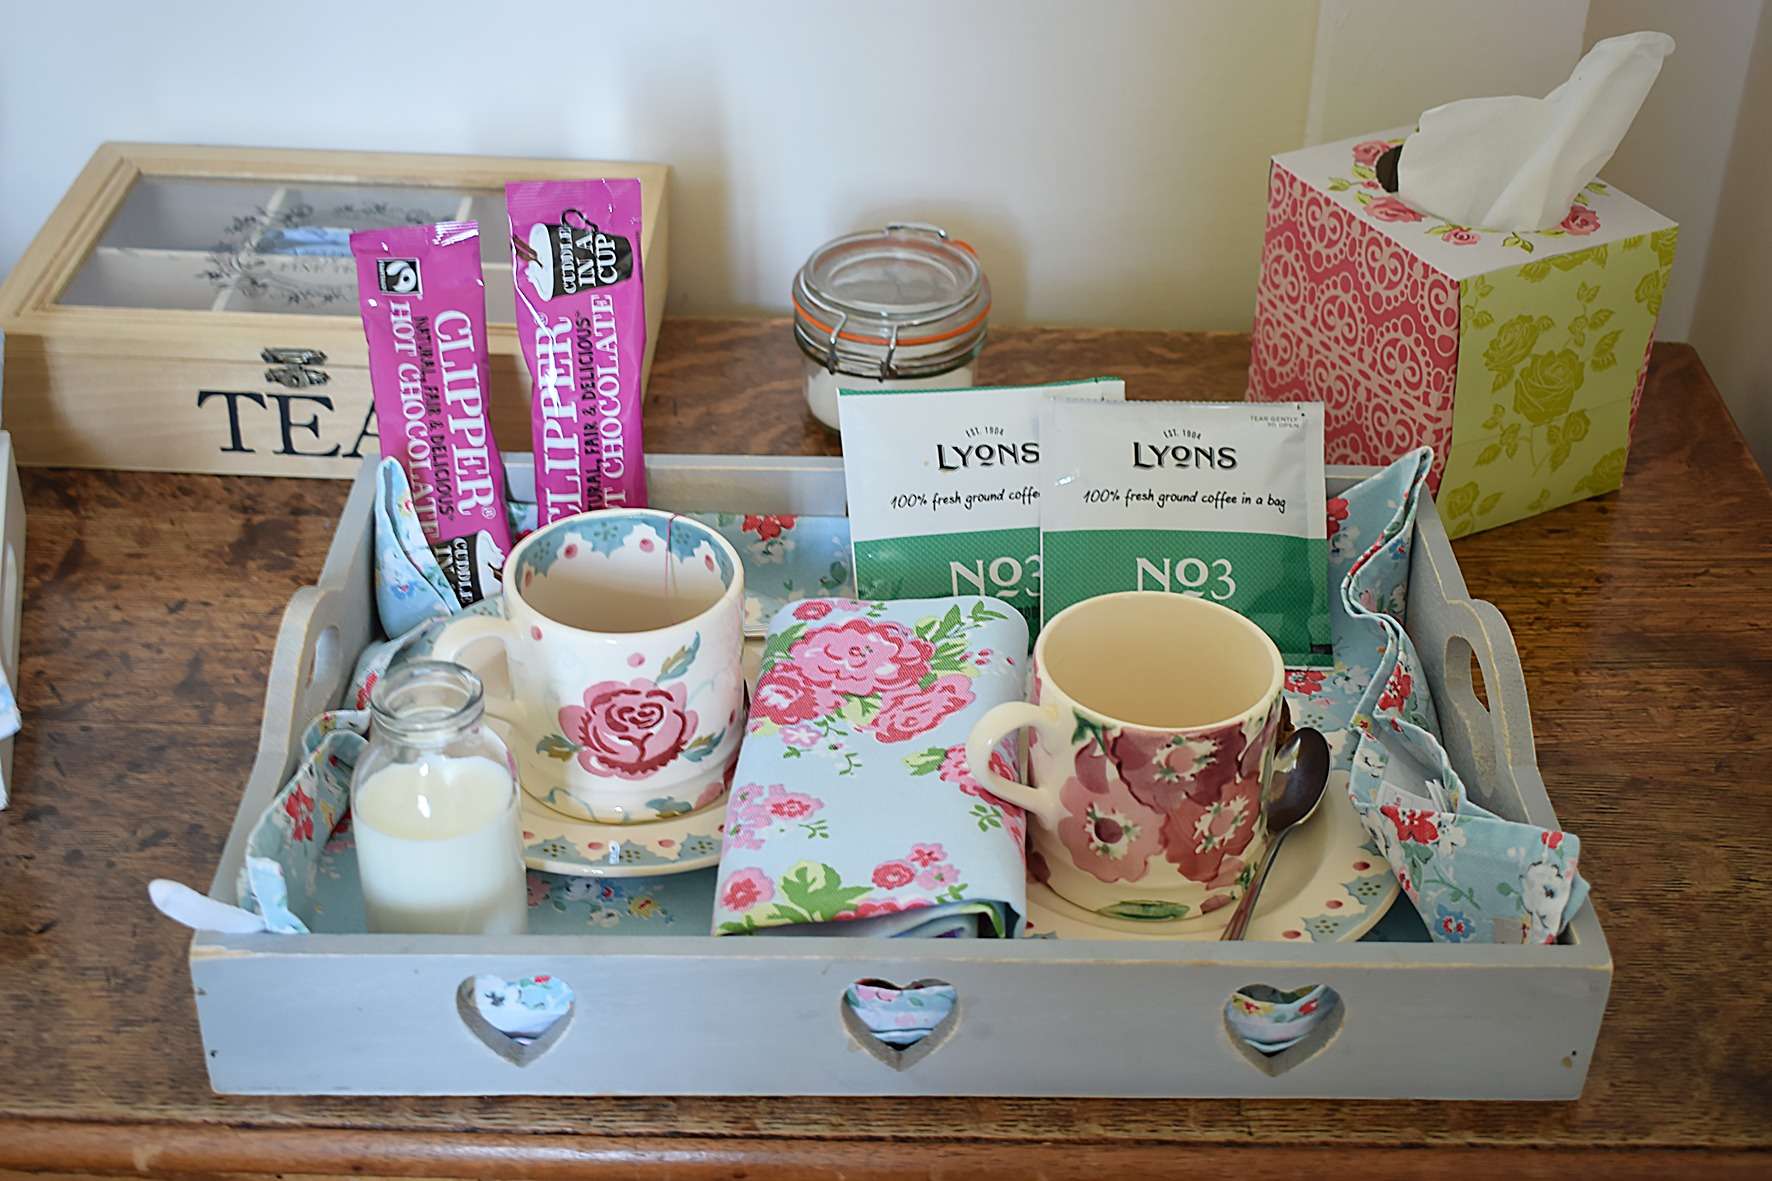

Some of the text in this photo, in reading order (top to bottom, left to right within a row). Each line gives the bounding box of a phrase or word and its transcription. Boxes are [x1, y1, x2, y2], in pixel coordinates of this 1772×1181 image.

[559, 226, 576, 294] CUDDLE
[575, 232, 597, 288] IN A
[595, 233, 618, 285] CUP
[423, 384, 442, 417] FAIR
[591, 294, 625, 480] CHOCOLATE
[390, 300, 440, 539] HOT CHOCOLATE
[429, 419, 444, 433] &
[582, 406, 597, 416] &
[584, 424, 599, 456] FAIR
[1132, 441, 1237, 470] LYONS
[936, 442, 1040, 471] LYONS
[890, 485, 1041, 512] 100% fresh ground coffe
[1083, 488, 1287, 515] 100% fresh ground coffee in a bag
[453, 537, 474, 604] CUDDLE
